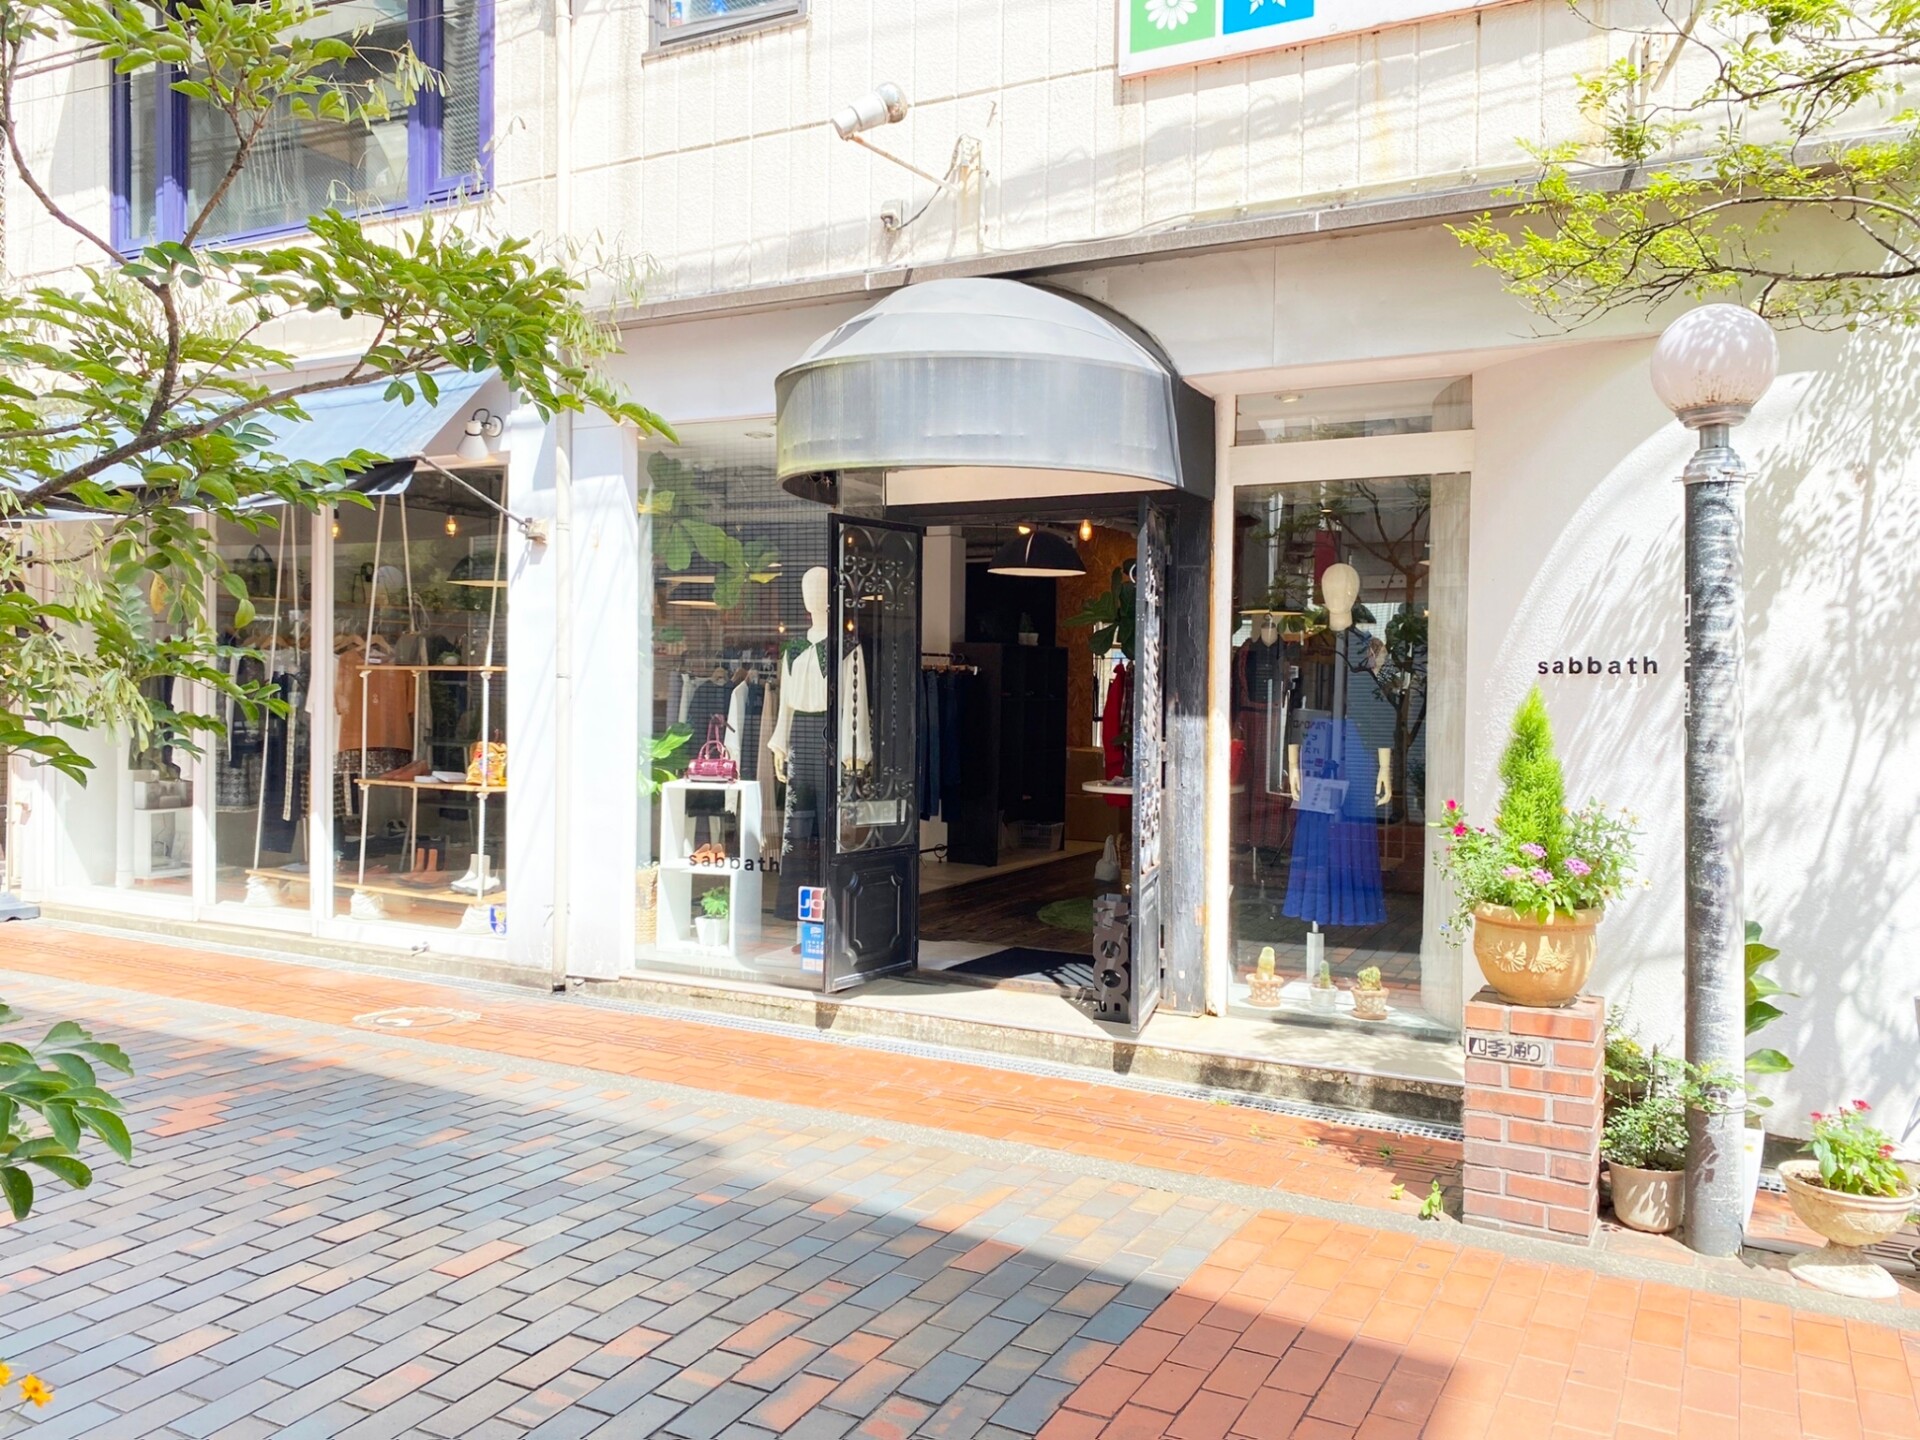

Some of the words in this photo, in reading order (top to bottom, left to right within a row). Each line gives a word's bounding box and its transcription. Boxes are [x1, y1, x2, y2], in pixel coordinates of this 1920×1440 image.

[1538, 656, 1658, 674] sabbath
[689, 852, 780, 872] sabbath
[1469, 1037, 1541, 1062] 四季通り
